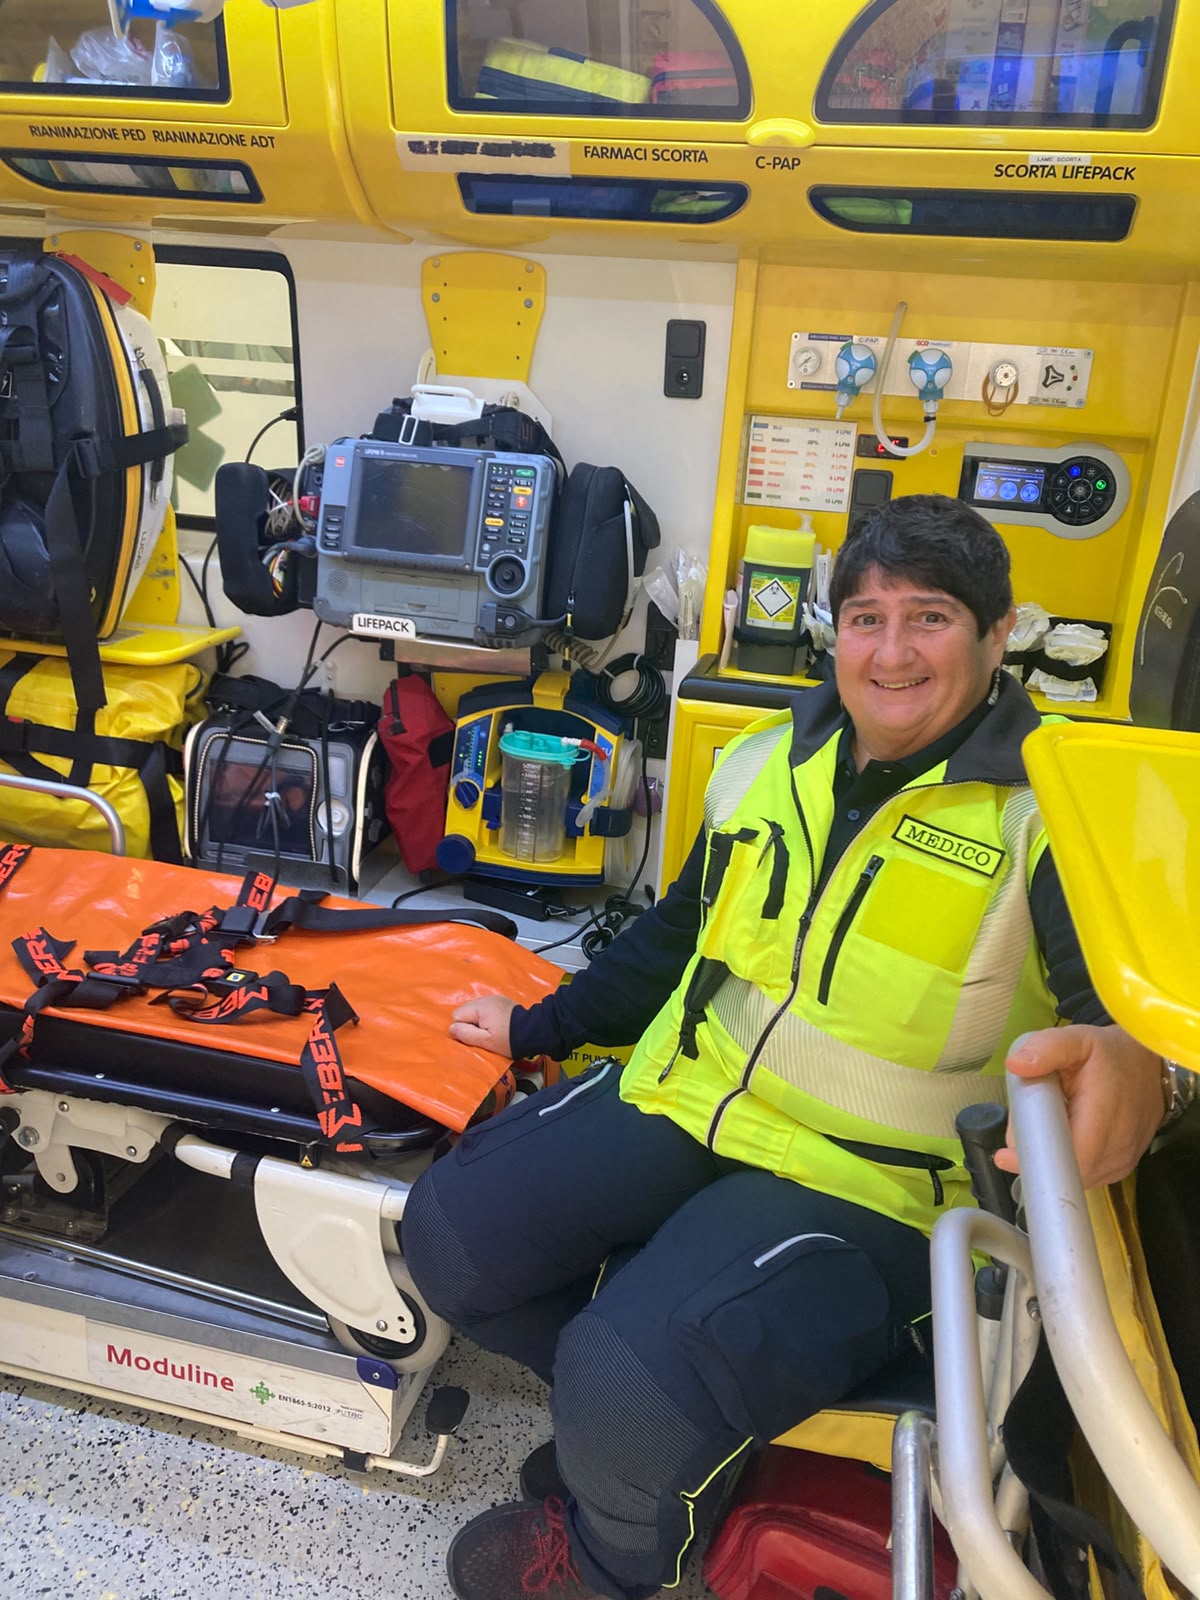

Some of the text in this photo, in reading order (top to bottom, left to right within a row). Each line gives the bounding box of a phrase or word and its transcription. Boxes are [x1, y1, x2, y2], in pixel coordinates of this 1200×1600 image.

[29, 125, 146, 142] RIANIMAZIONE PED
[152, 129, 276, 149] RIANIMAZIONE ADT
[584, 146, 709, 163] FARMACI SCORTA
[755, 156, 801, 170] C-PAP
[994, 164, 1136, 181] SCORTA LIFEPACK
[358, 616, 410, 633] LIFEPACK
[905, 825, 991, 867] MEDICO
[107, 1344, 235, 1392] Moduline
[278, 1394, 332, 1413] EN1865-5:2012
